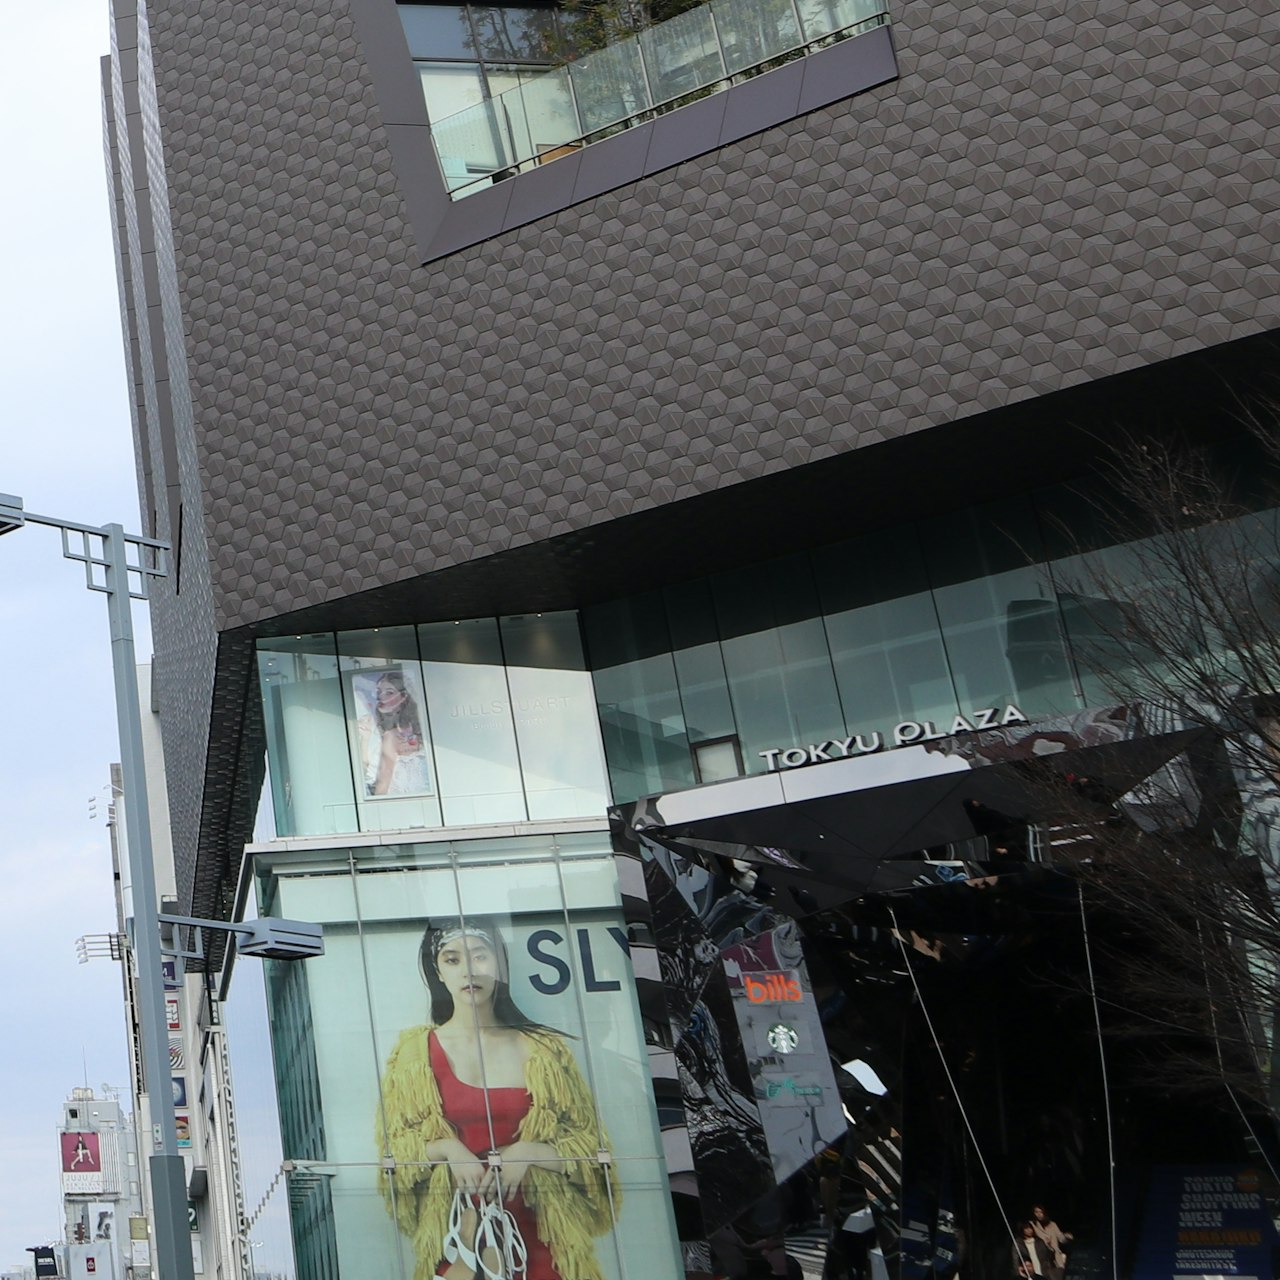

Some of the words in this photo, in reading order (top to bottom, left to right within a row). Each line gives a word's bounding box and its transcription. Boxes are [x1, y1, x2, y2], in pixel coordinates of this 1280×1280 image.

[759, 732, 883, 772] TOKYU
[894, 704, 1028, 747] PLAZA
[745, 974, 803, 1003] bills
[1180, 1193, 1261, 1210] SHOPPING
